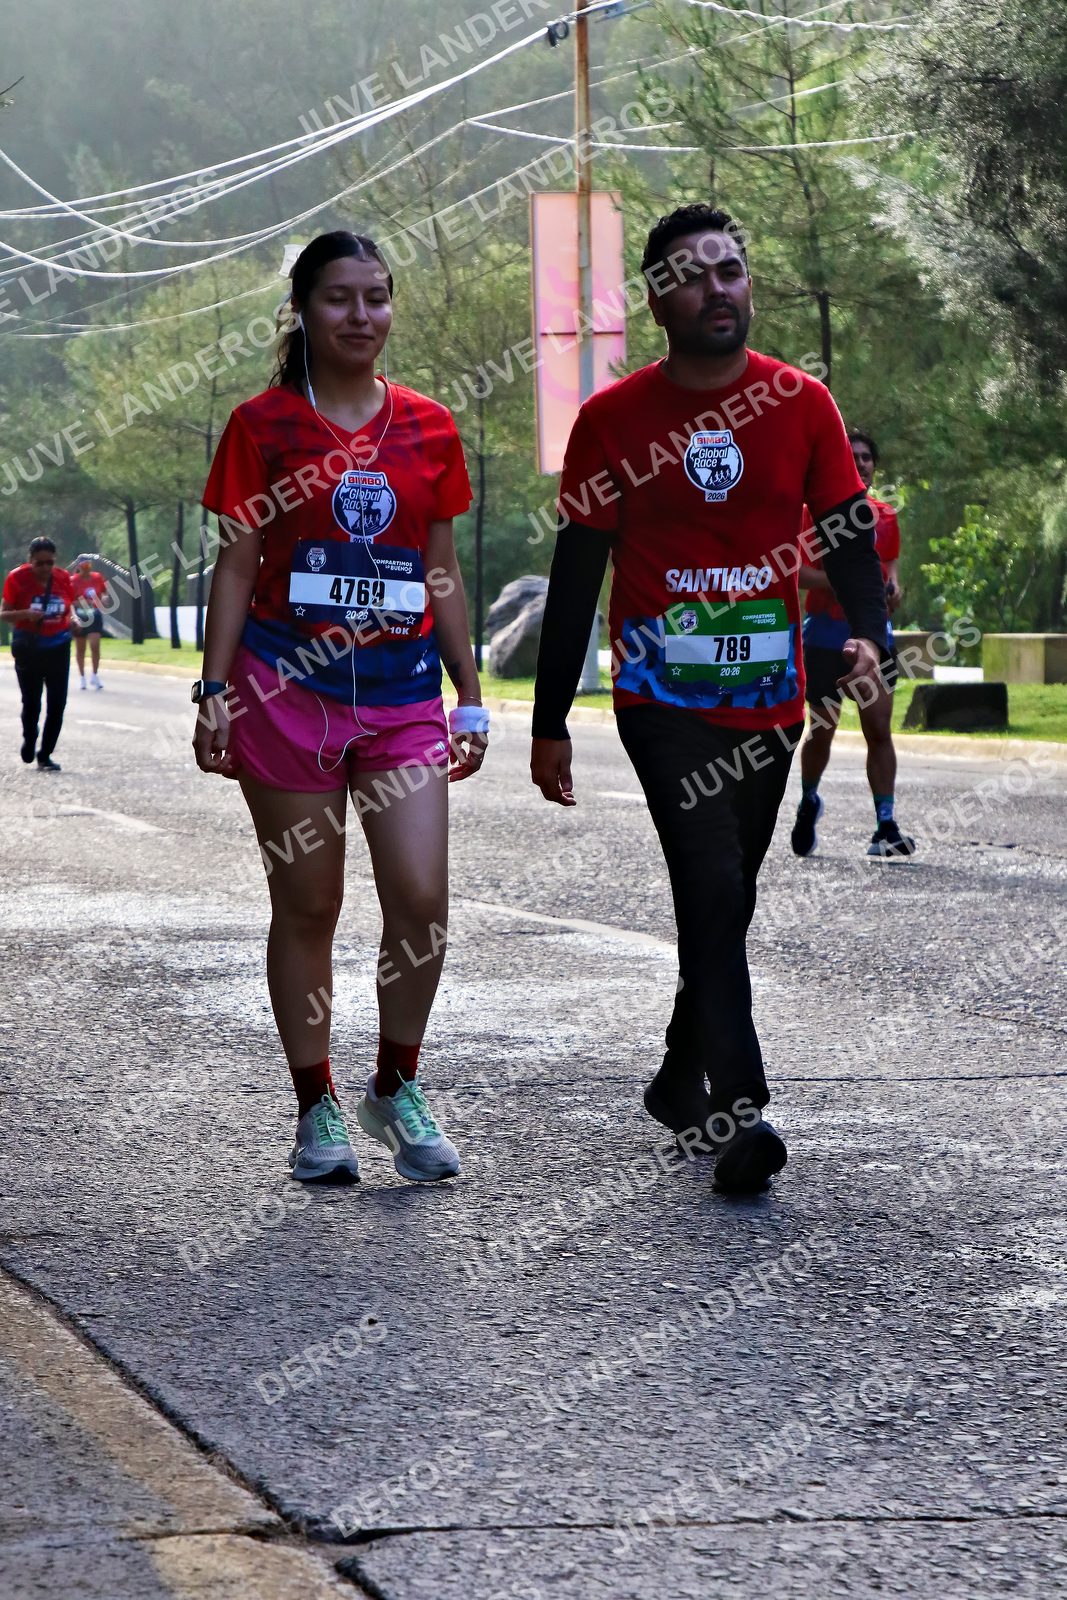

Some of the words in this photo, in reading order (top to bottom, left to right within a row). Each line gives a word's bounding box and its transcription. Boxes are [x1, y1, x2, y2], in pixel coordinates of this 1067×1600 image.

[697, 436, 727, 444] BIMBO
[699, 447, 728, 459] Global
[693, 457, 718, 468] Race
[348, 476, 382, 485] BIMBO
[349, 488, 381, 501] Global
[707, 492, 726, 500] 2026
[342, 498, 369, 511] Race
[372, 558, 413, 567] COMPARTIMOS
[665, 565, 773, 593] SANTIAGO
[329, 577, 385, 607] 4769
[390, 626, 410, 635] 10K
[713, 635, 751, 662] 789
[762, 675, 771, 683] 3K
